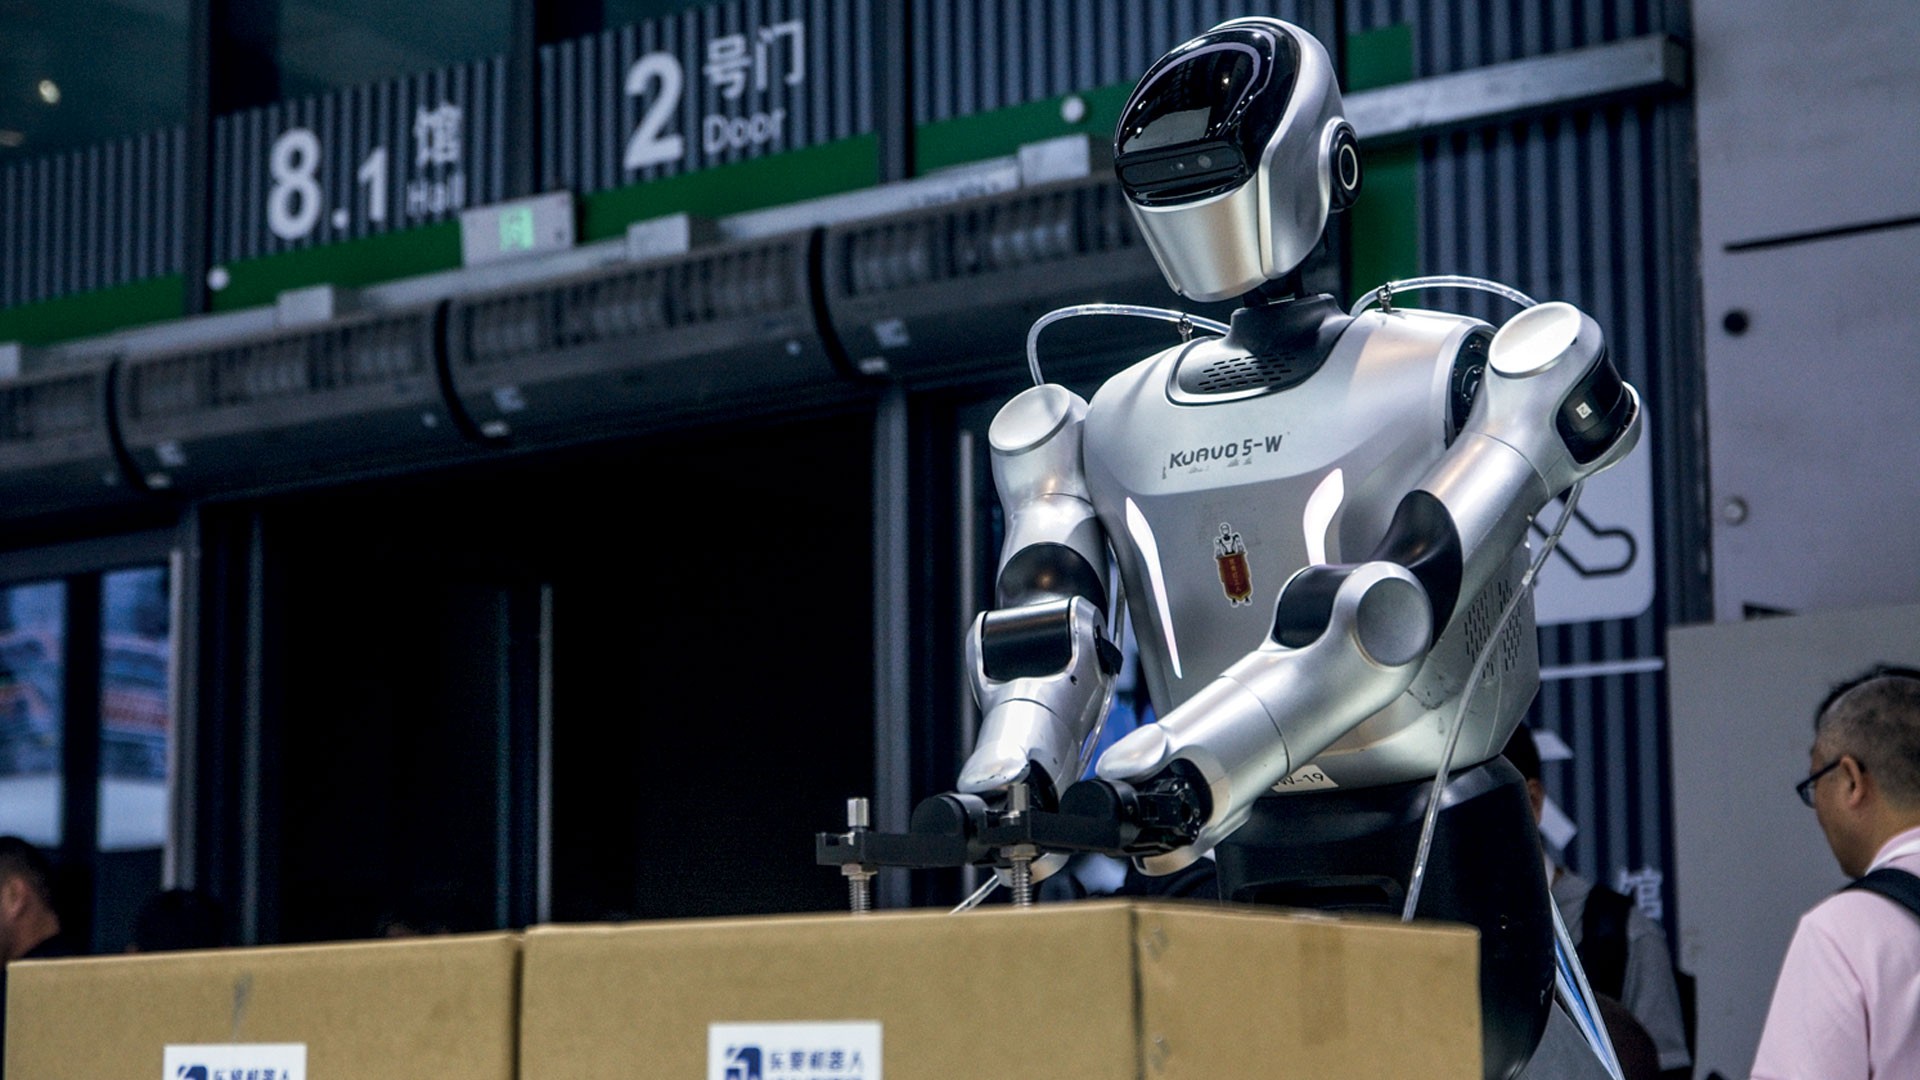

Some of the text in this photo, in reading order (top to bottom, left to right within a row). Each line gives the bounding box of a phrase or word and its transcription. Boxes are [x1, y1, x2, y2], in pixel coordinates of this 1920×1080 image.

[624, 20, 806, 171] 2 号门
[703, 108, 787, 155] Door
[267, 103, 464, 240] 8.1 馆
[1169, 434, 1283, 469] KUAVO 5-W
[1274, 772, 1324, 787] W-19
